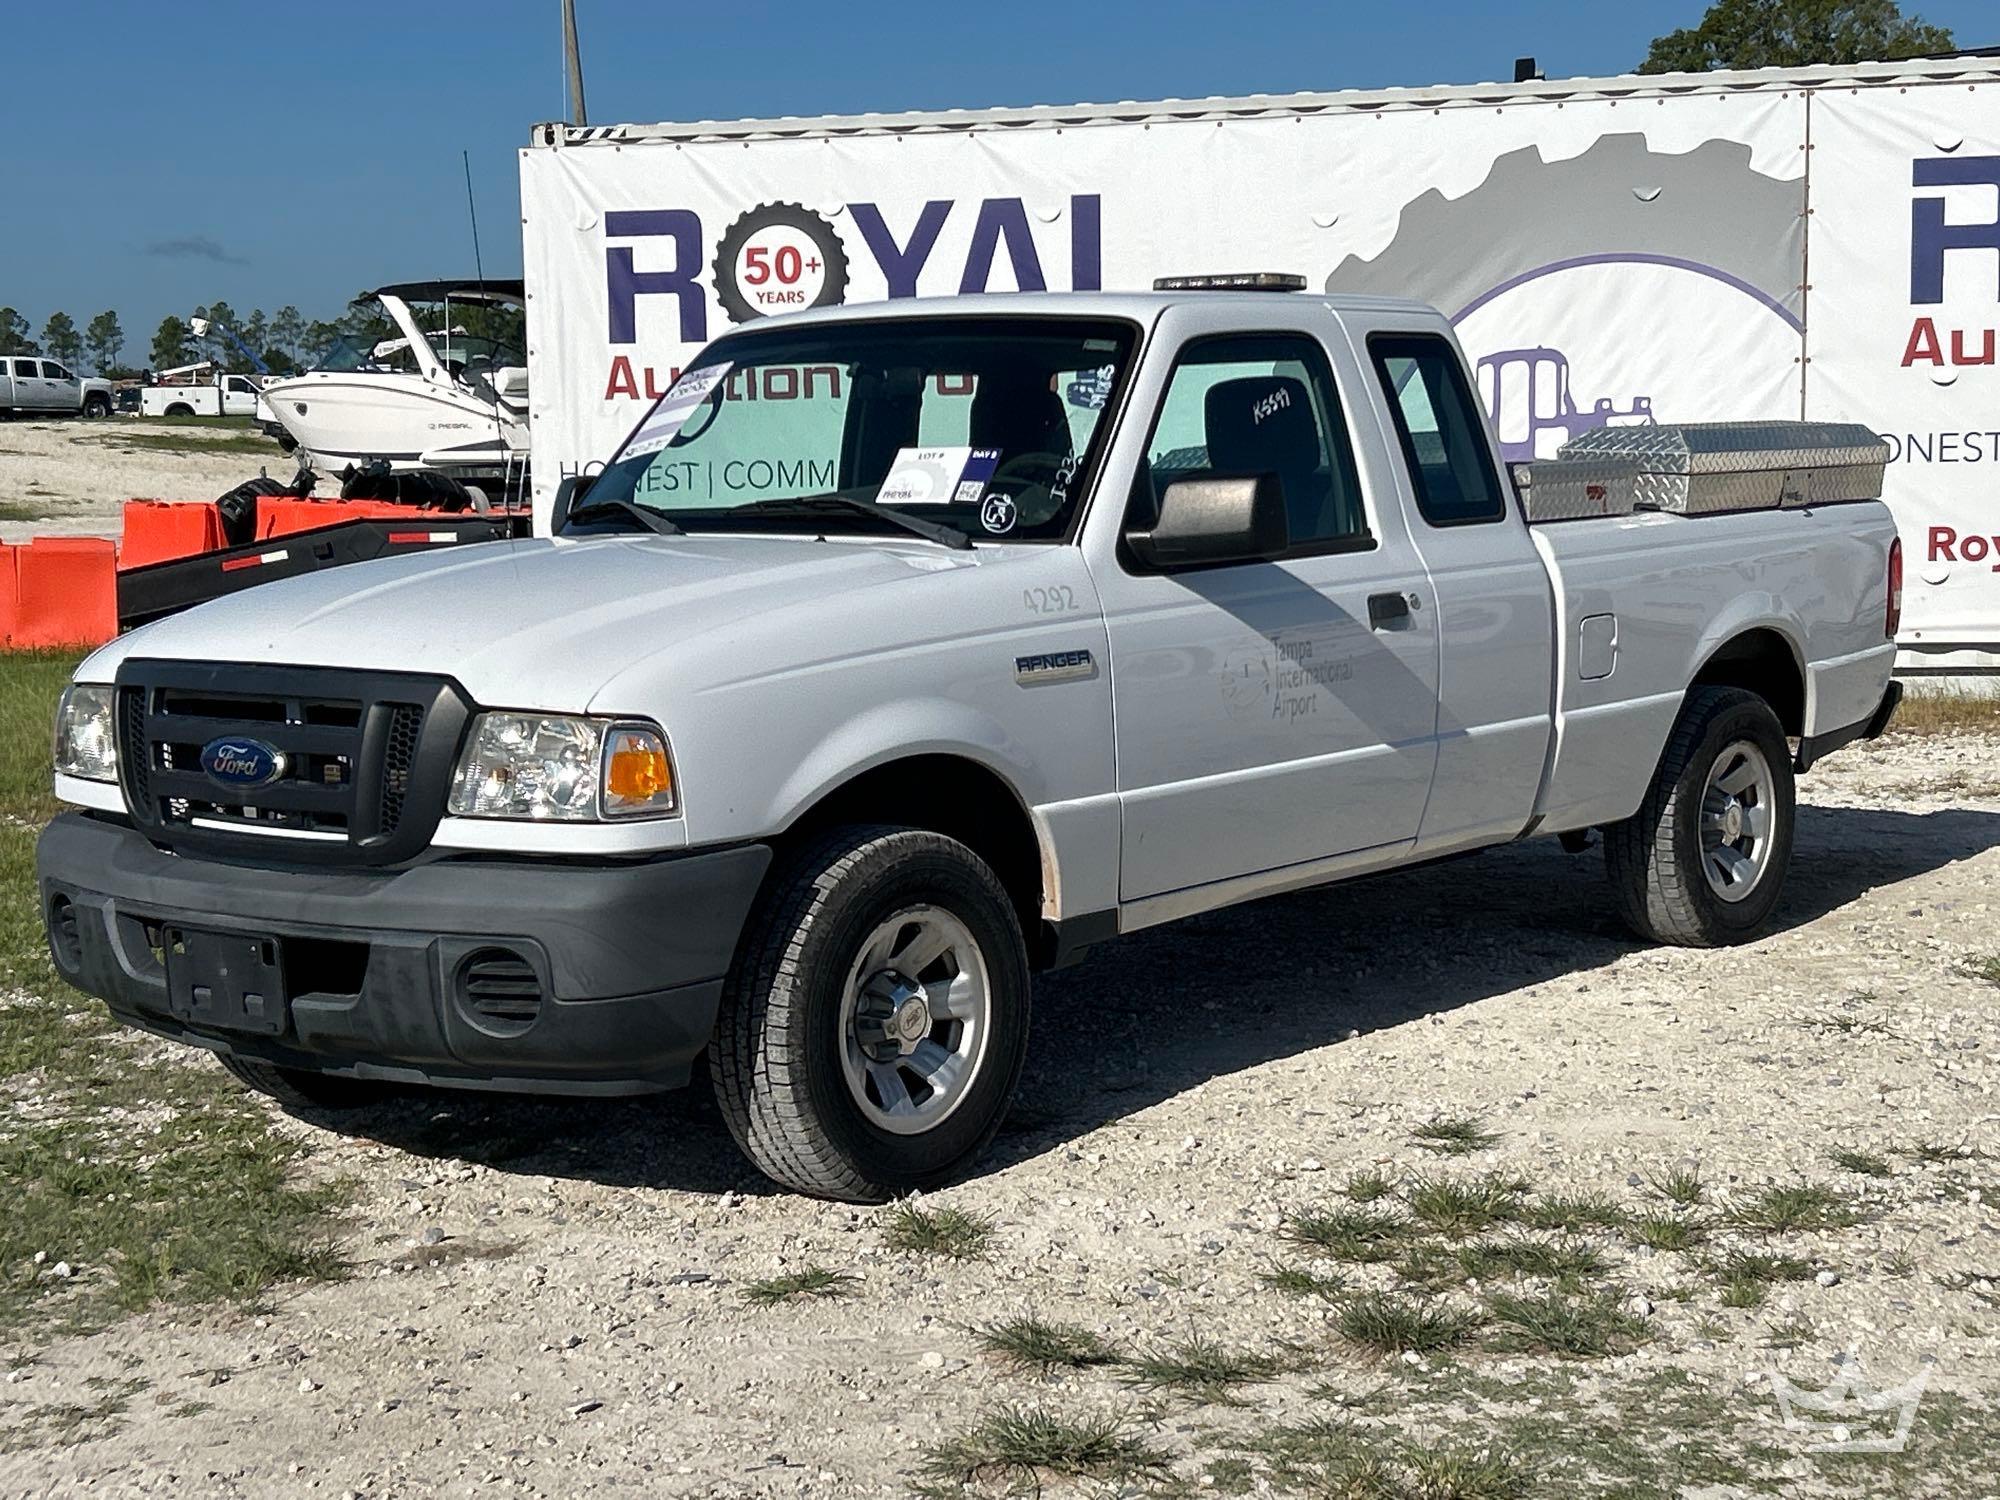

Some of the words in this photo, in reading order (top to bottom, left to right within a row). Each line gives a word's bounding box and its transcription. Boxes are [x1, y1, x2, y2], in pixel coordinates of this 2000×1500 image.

[744, 246, 821, 285] 50+
[756, 290, 805, 304] YEARS
[605, 356, 841, 401] Aution
[1016, 650, 1091, 674] RANGER
[1270, 636, 1313, 667] Tampa
[1274, 655, 1354, 690] International
[1272, 691, 1318, 725] Airport
[213, 744, 259, 776] Ford
